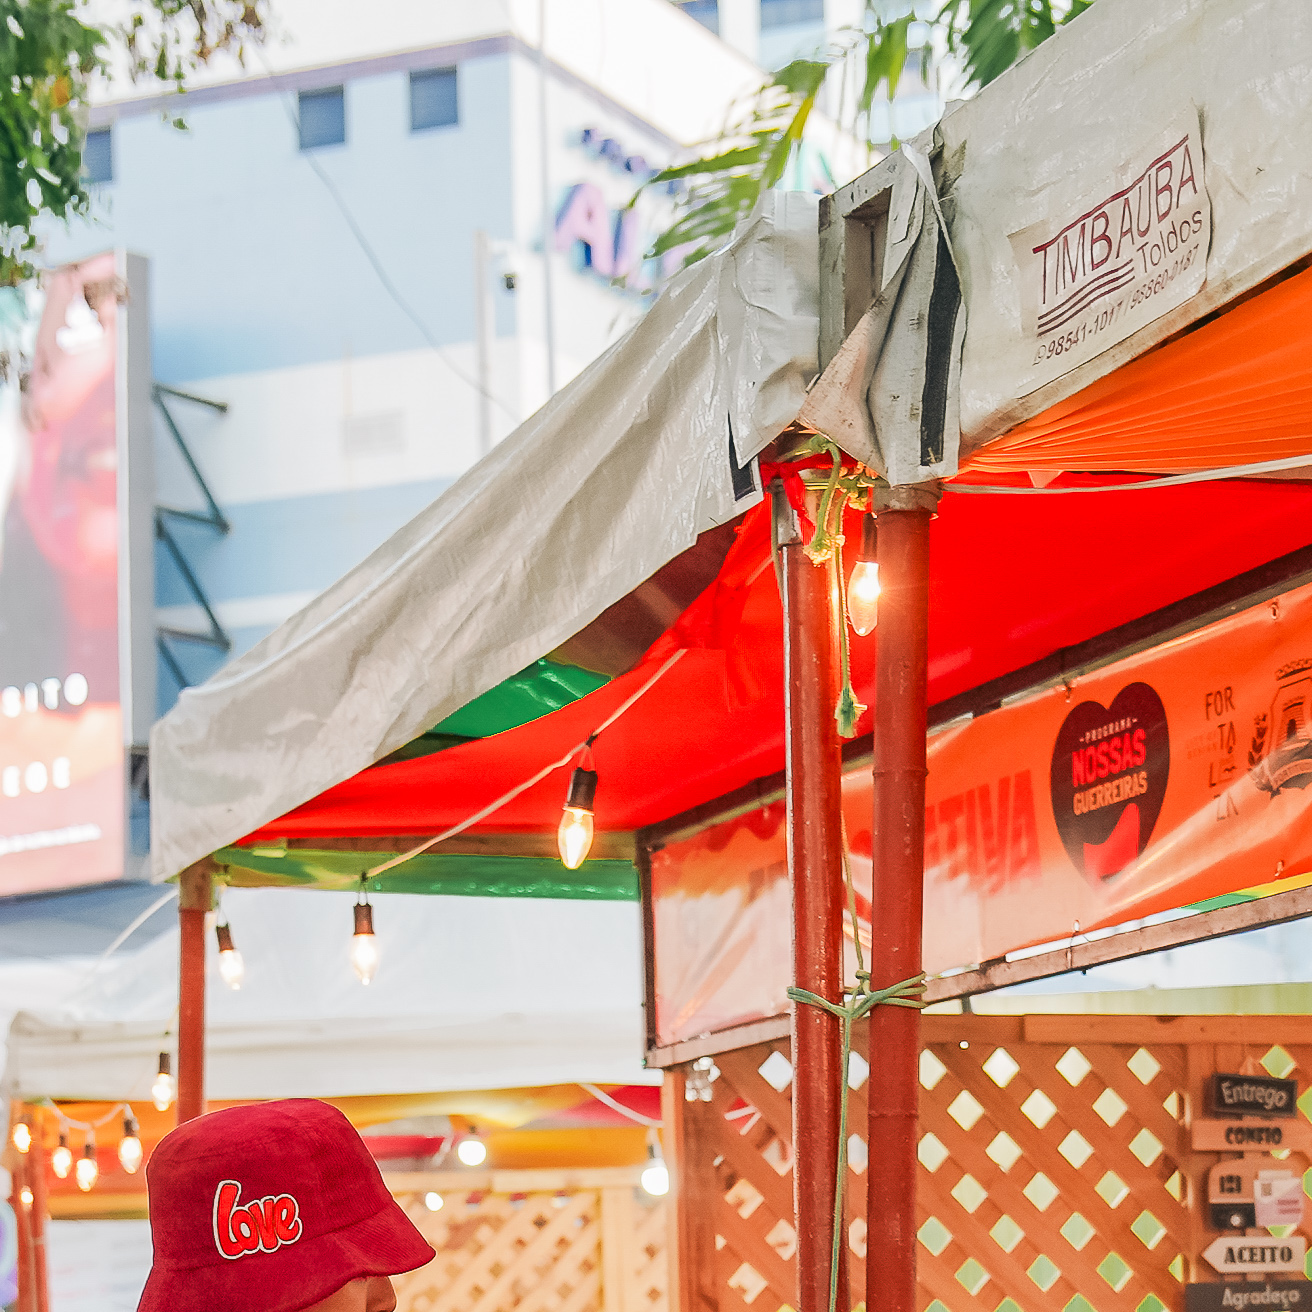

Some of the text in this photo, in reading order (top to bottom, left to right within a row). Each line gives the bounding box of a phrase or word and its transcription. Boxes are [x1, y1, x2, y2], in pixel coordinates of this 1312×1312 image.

[1031, 141, 1198, 305] TIMBAUBA
[1137, 209, 1202, 274] Toldos
[1205, 685, 1236, 722] FOR
[1071, 728, 1147, 788] NOSSAS
[1072, 770, 1149, 817] GUERREIRAS
[1221, 1080, 1288, 1110] Entrego
[1224, 1246, 1294, 1265] ACEITO
